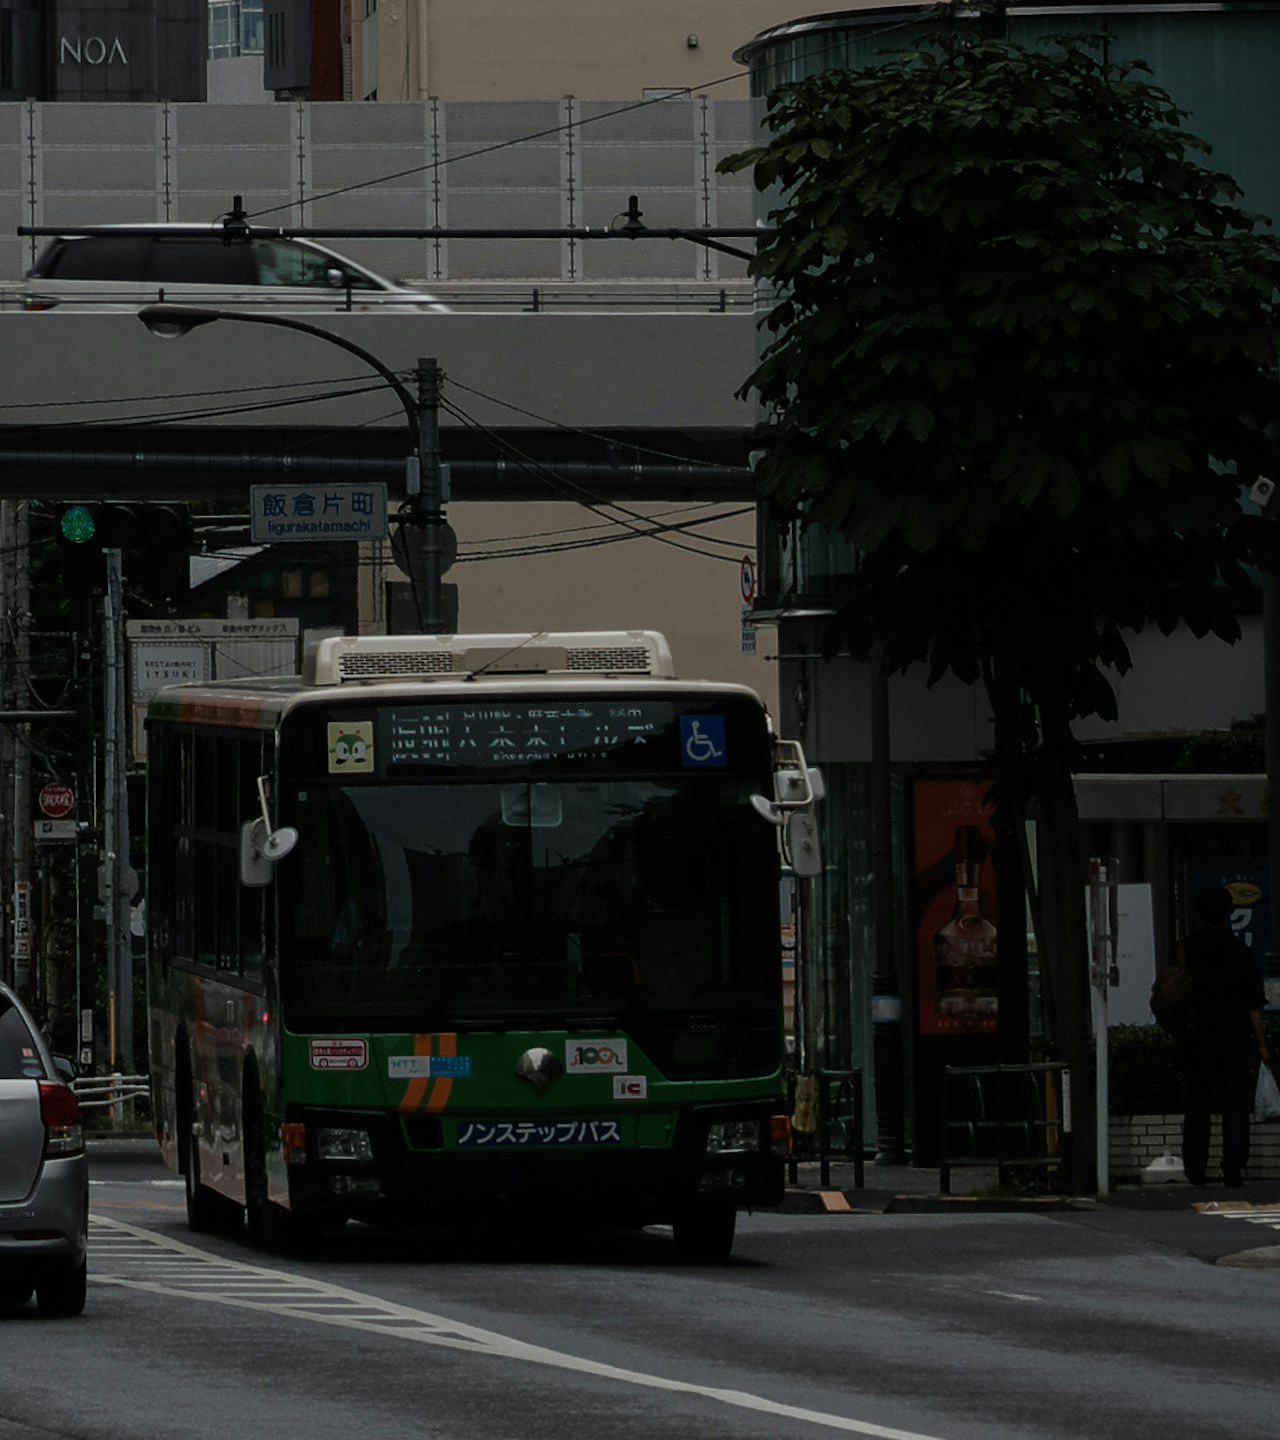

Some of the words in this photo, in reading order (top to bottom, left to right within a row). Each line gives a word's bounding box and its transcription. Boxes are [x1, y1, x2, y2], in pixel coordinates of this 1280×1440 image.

[262, 491, 375, 518] 飯倉片町
[457, 1120, 622, 1146] ノンステップバス
